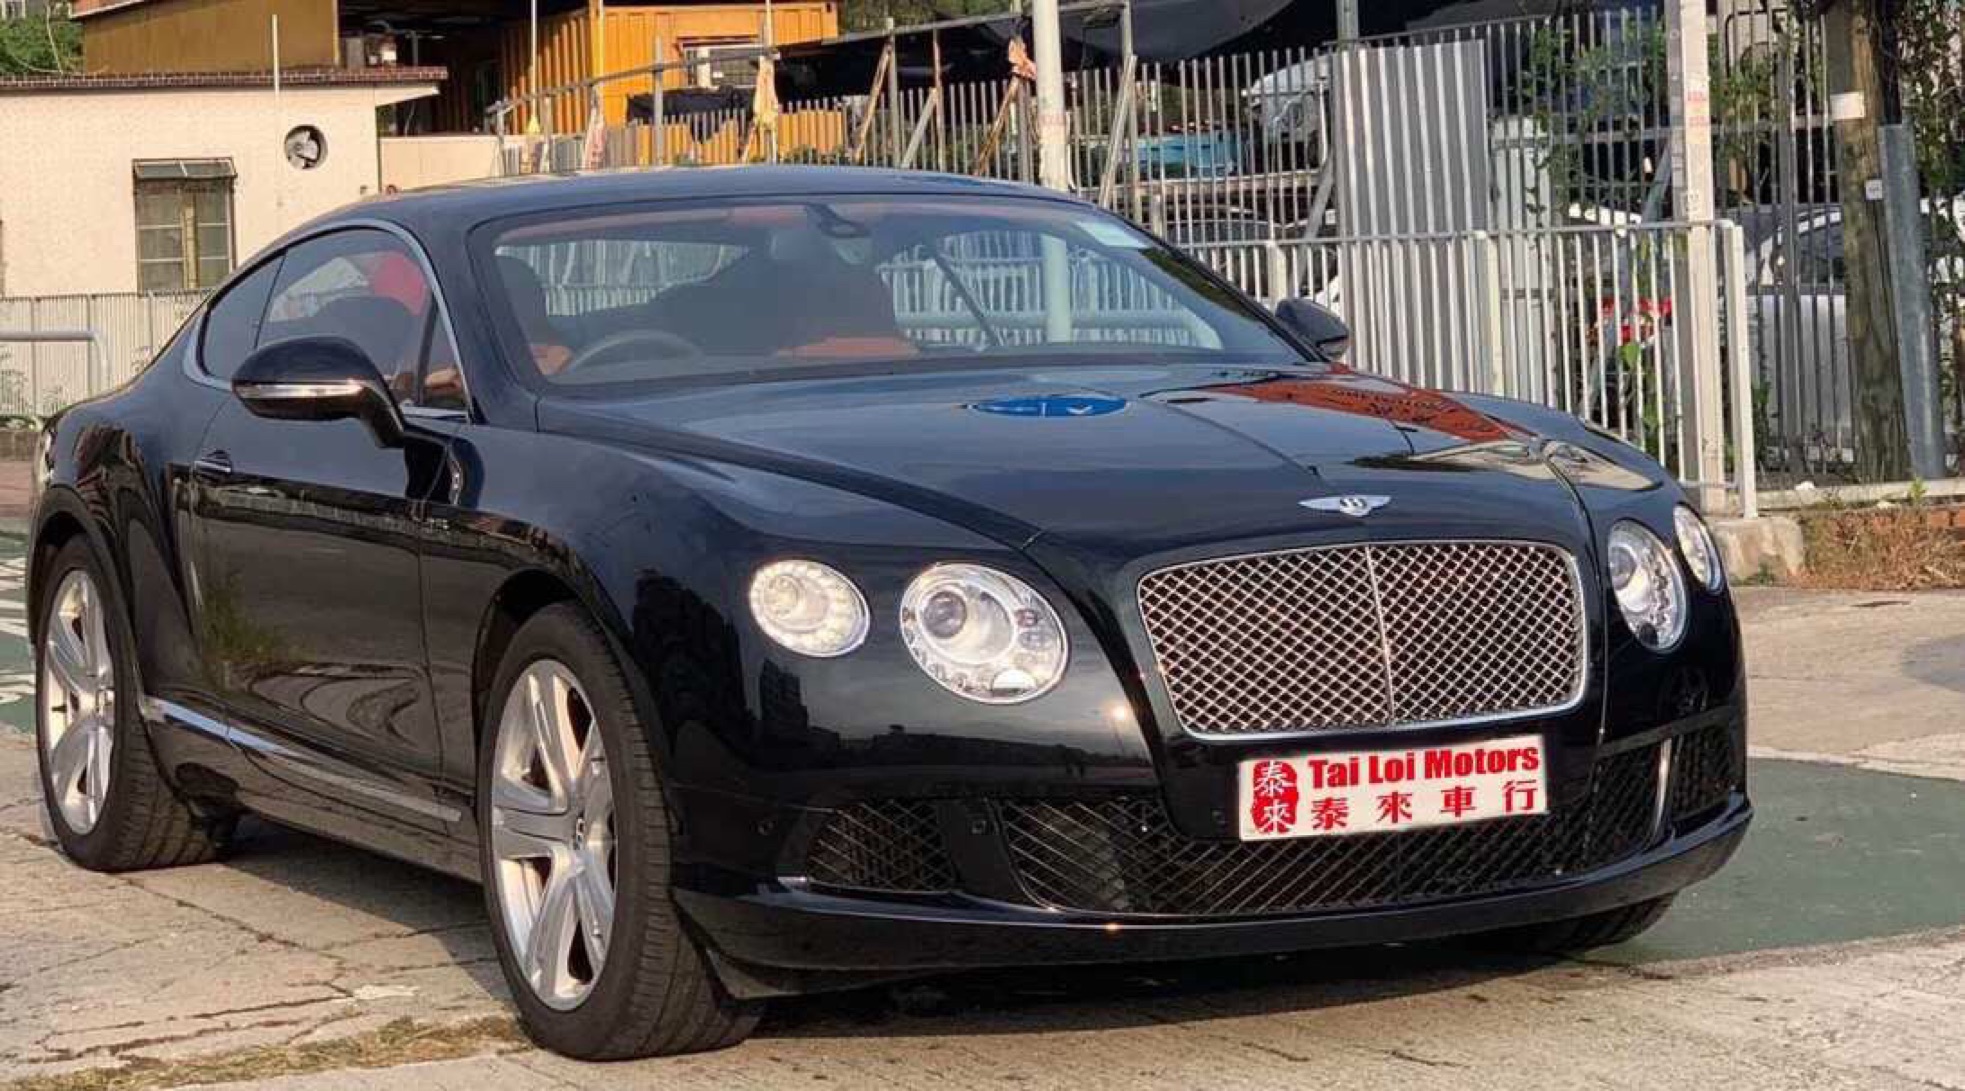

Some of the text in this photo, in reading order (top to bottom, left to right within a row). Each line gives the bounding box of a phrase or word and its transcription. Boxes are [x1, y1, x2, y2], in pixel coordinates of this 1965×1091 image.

[1307, 746, 1540, 789] Tai Loi Motors
[1309, 778, 1539, 831] 泰來車行
